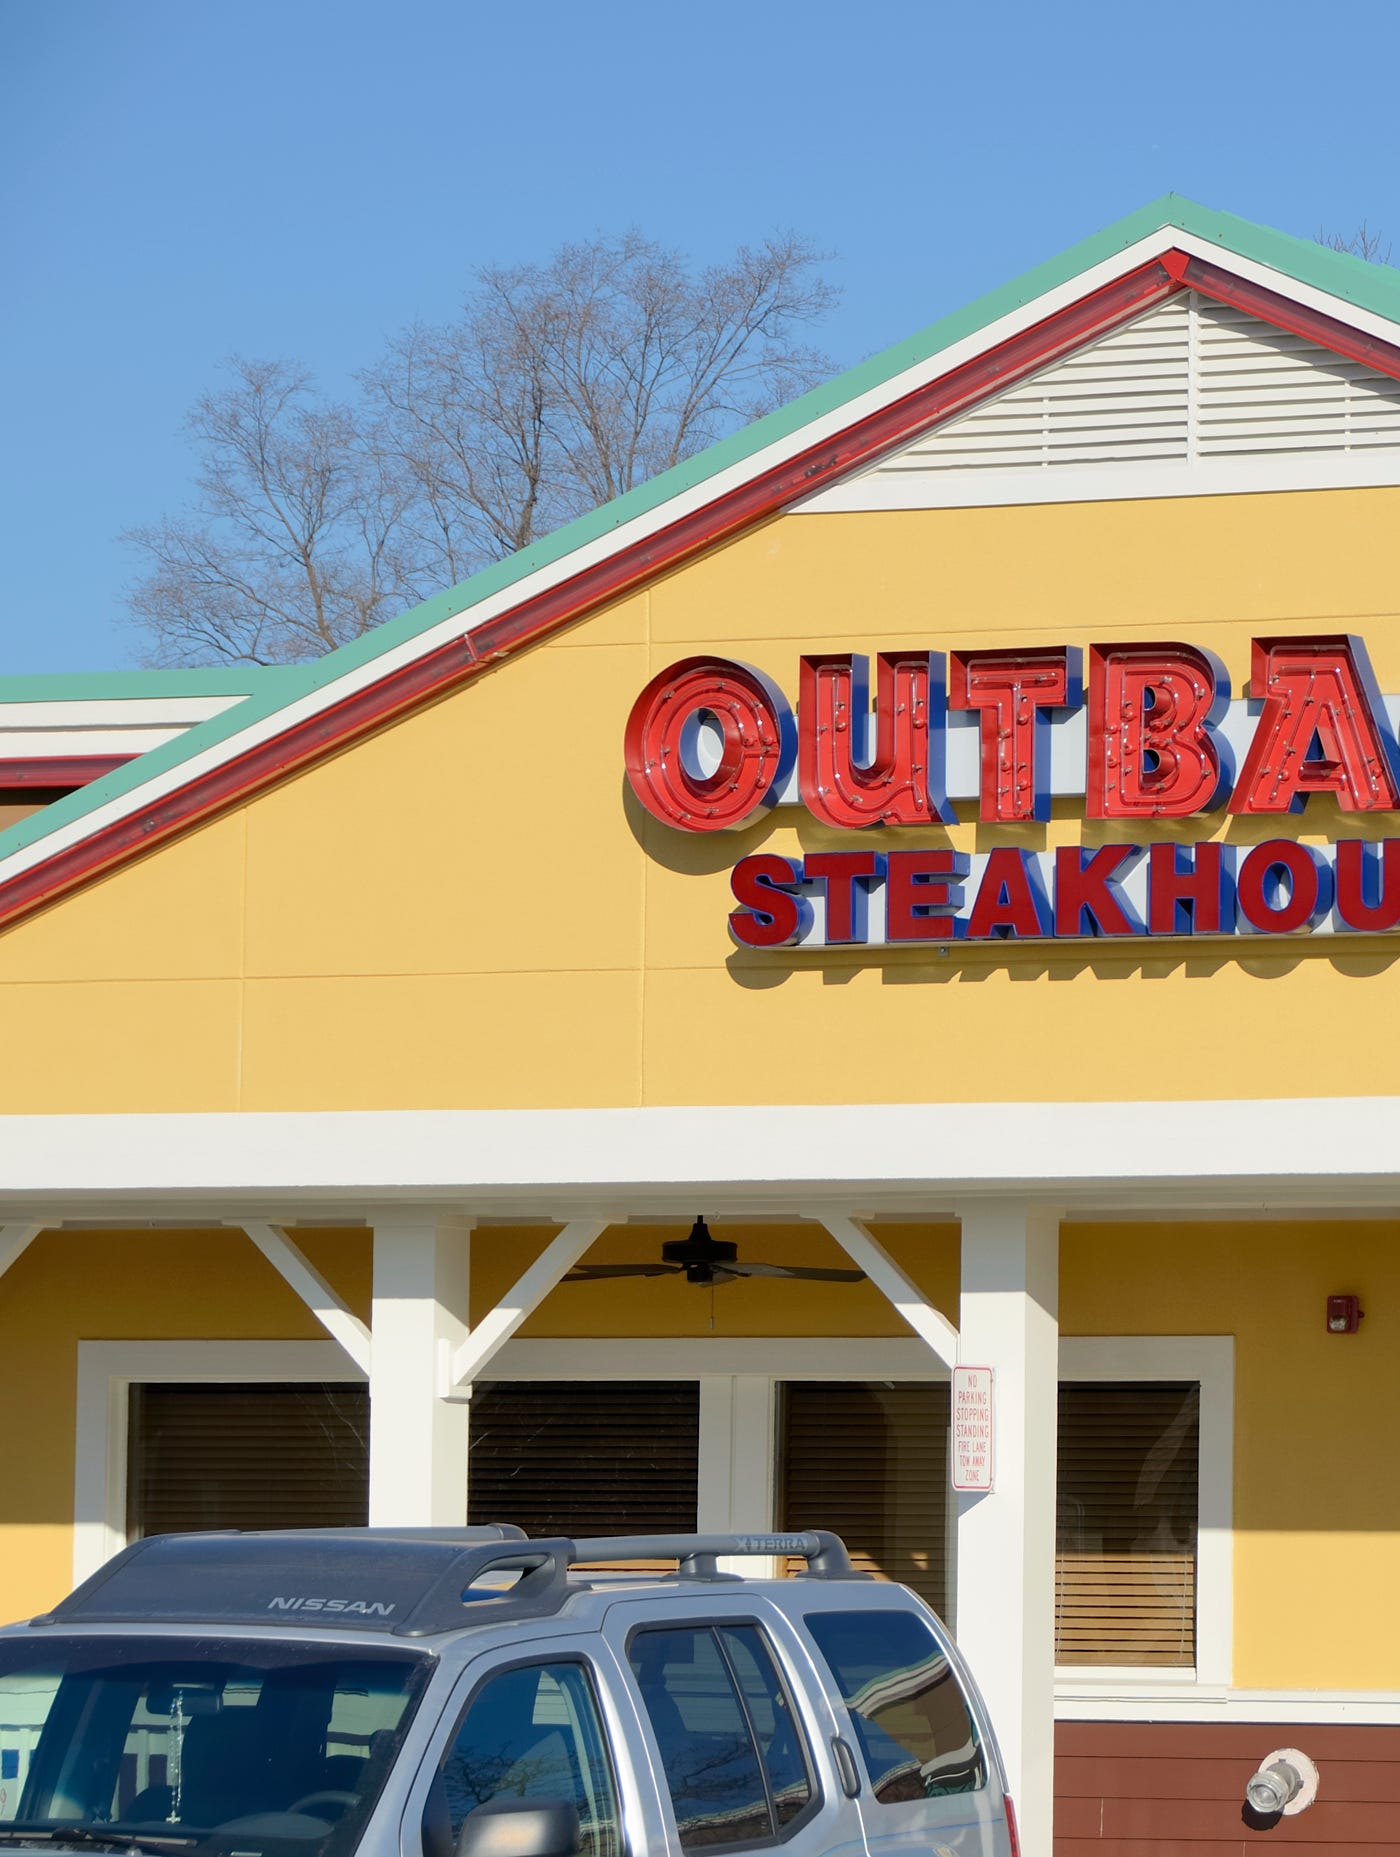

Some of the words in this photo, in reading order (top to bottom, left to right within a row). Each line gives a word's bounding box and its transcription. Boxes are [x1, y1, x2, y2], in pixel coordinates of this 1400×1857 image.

[968, 1375, 977, 1388] NO
[958, 1391, 987, 1405] PARKING
[956, 1407, 989, 1421] STOPPING
[956, 1424, 989, 1438] STANDING
[958, 1441, 970, 1453] FIRE
[972, 1441, 986, 1453] LANE
[960, 1455, 970, 1467] TOW
[973, 1455, 985, 1467] AWAY
[965, 1469, 980, 1482] ZONE
[735, 1536, 808, 1552] XTERRA
[267, 1597, 396, 1616] NISSAN
